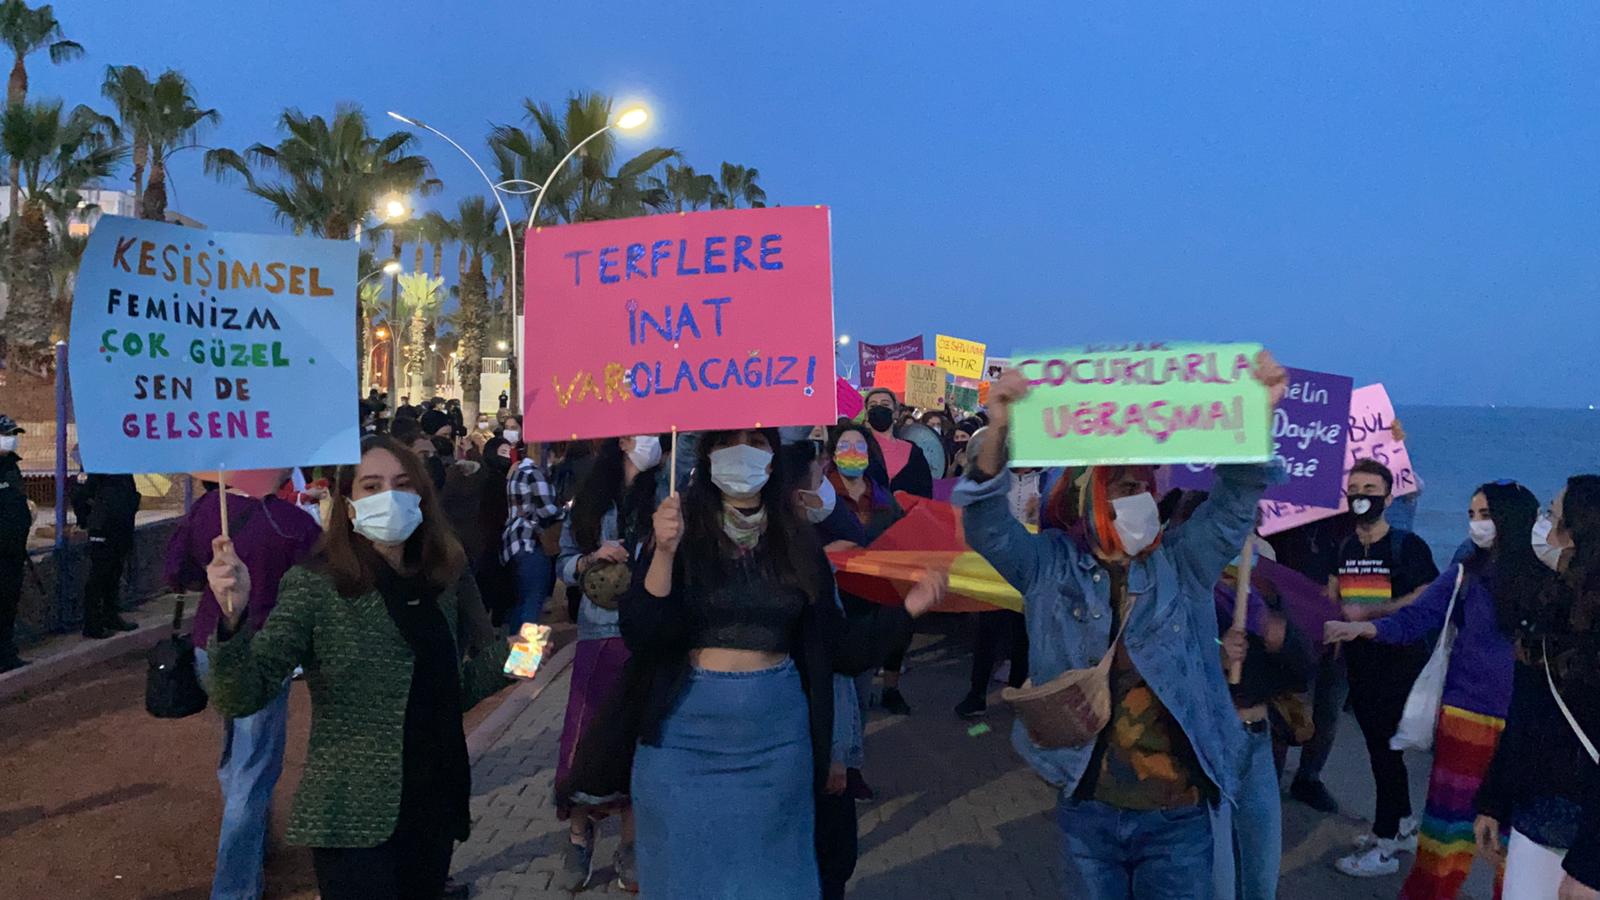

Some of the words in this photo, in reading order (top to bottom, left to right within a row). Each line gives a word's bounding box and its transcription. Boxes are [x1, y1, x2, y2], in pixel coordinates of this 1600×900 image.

[564, 234, 784, 287] TERFLERE
[626, 296, 732, 345] İNAT
[101, 328, 170, 363] ÇOK
[189, 339, 290, 367] GÜZEL
[134, 375, 193, 400] SEN
[215, 376, 250, 400] DE
[122, 410, 273, 439] GELSENE
